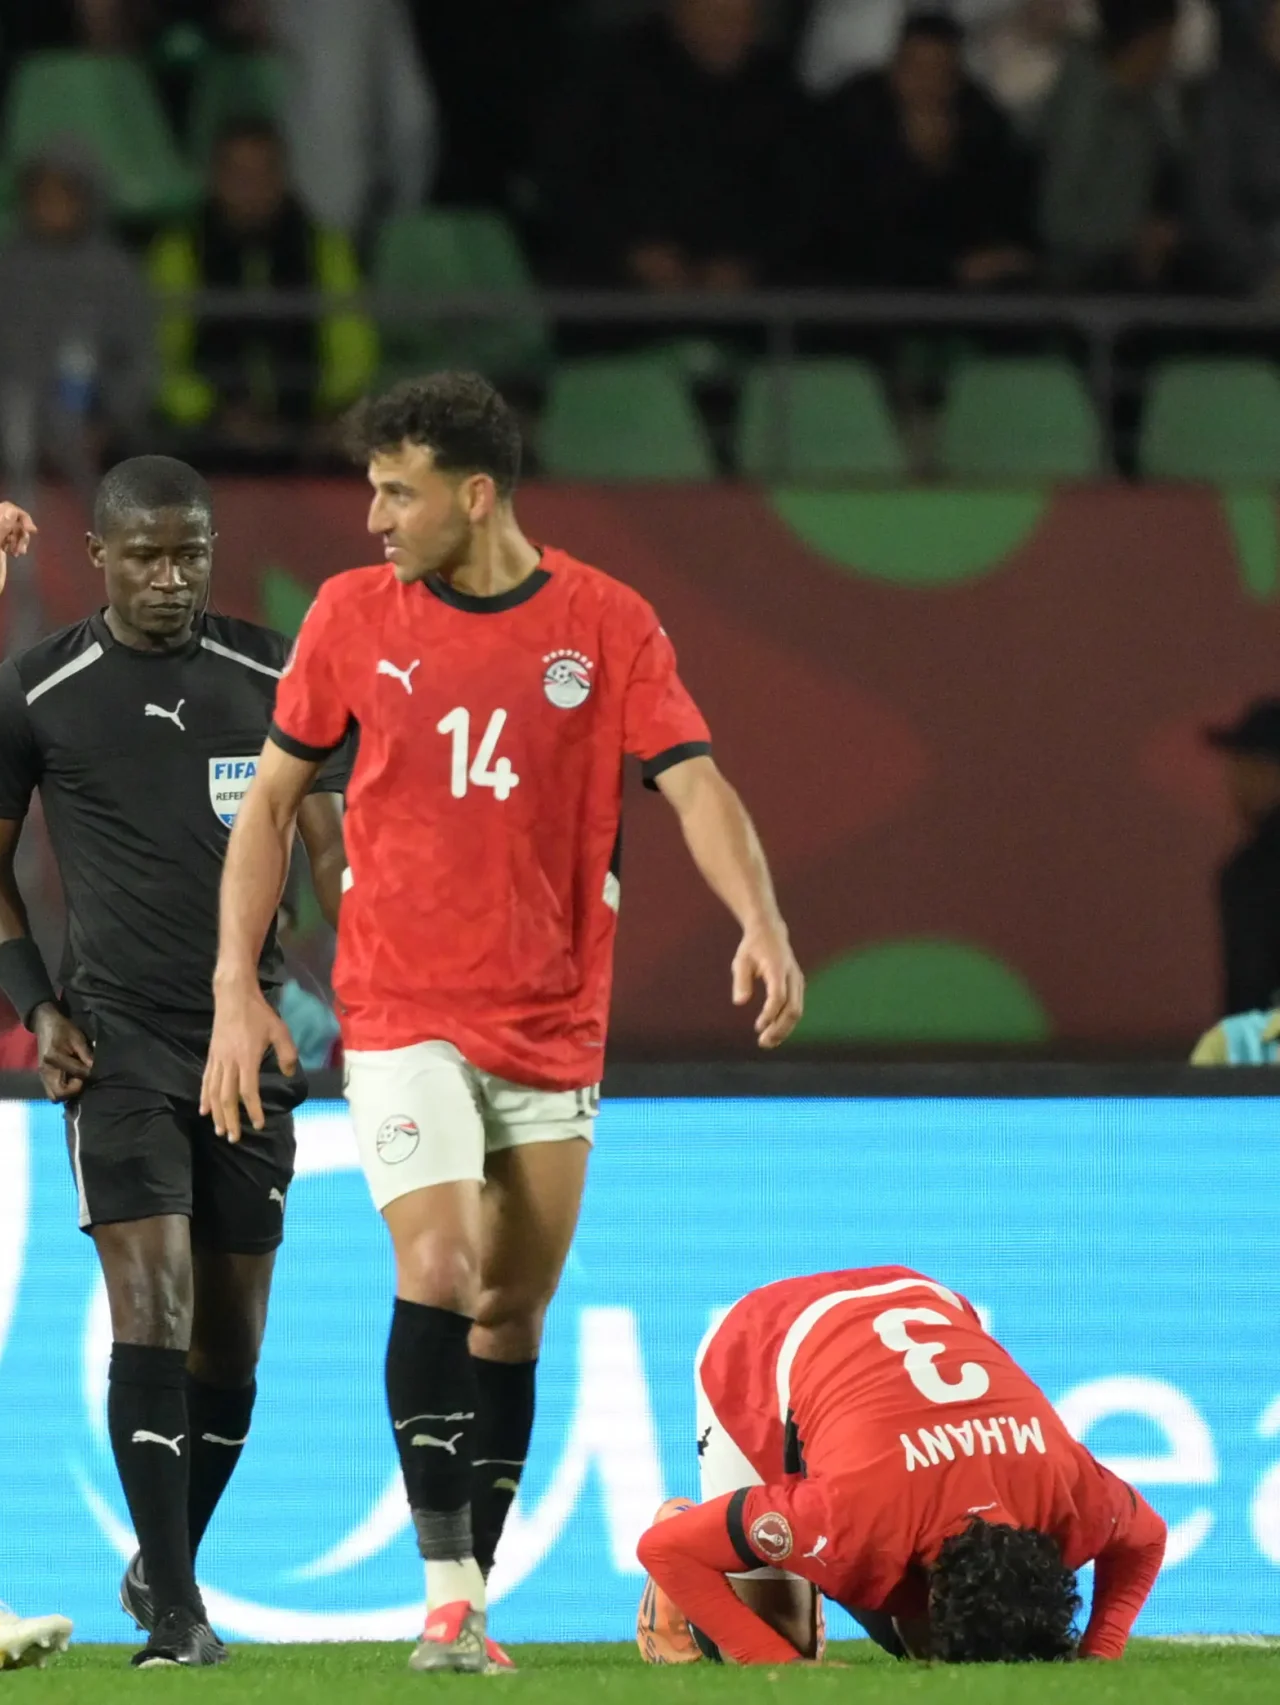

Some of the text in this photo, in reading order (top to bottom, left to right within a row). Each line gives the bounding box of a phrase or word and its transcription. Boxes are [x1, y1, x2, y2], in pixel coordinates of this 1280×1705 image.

[214, 761, 257, 780] FIFA
[437, 706, 519, 801] 14
[872, 1307, 990, 1405] 3
[899, 1416, 1047, 1472] M.HANY
